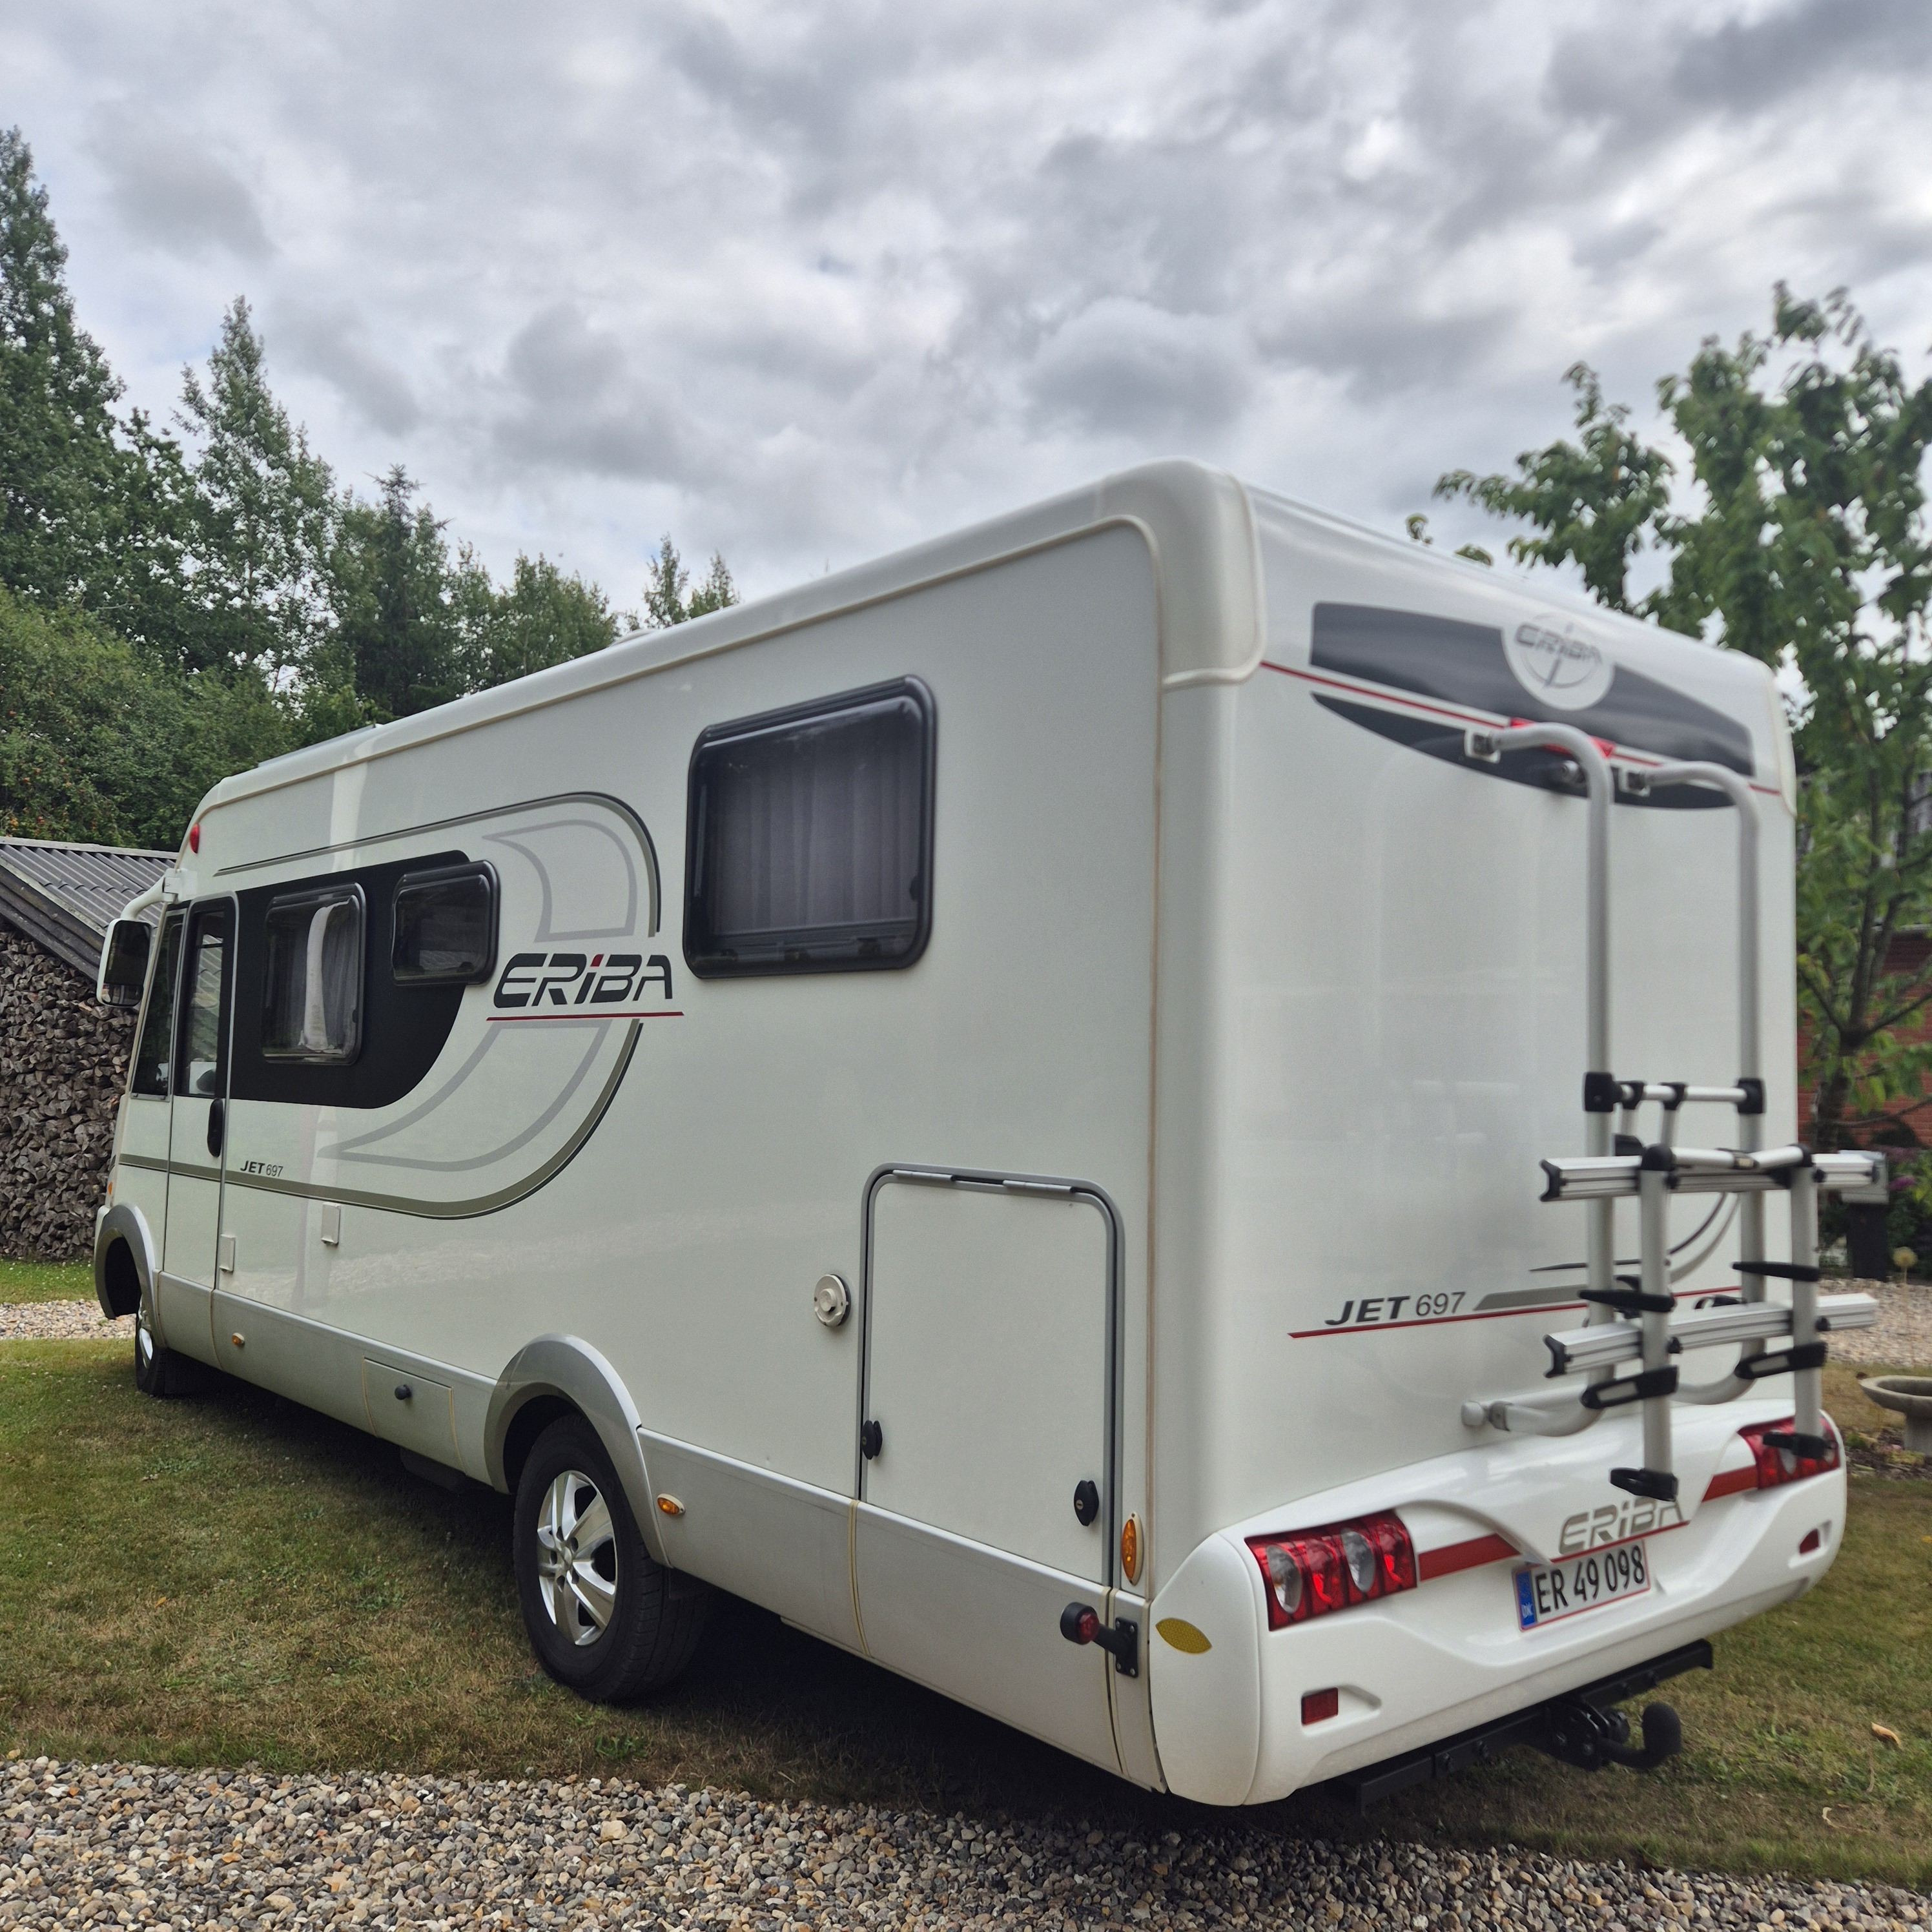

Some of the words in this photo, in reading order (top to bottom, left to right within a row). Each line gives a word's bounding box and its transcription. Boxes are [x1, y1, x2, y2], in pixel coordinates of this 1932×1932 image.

[240, 1160, 265, 1174] JET
[266, 1164, 283, 1177] 697
[1324, 1296, 1411, 1325] JET
[1416, 1291, 1465, 1317] 697
[1535, 1568, 1568, 1614] ER
[1574, 1557, 1600, 1602] 49
[1605, 1545, 1646, 1592] 098
